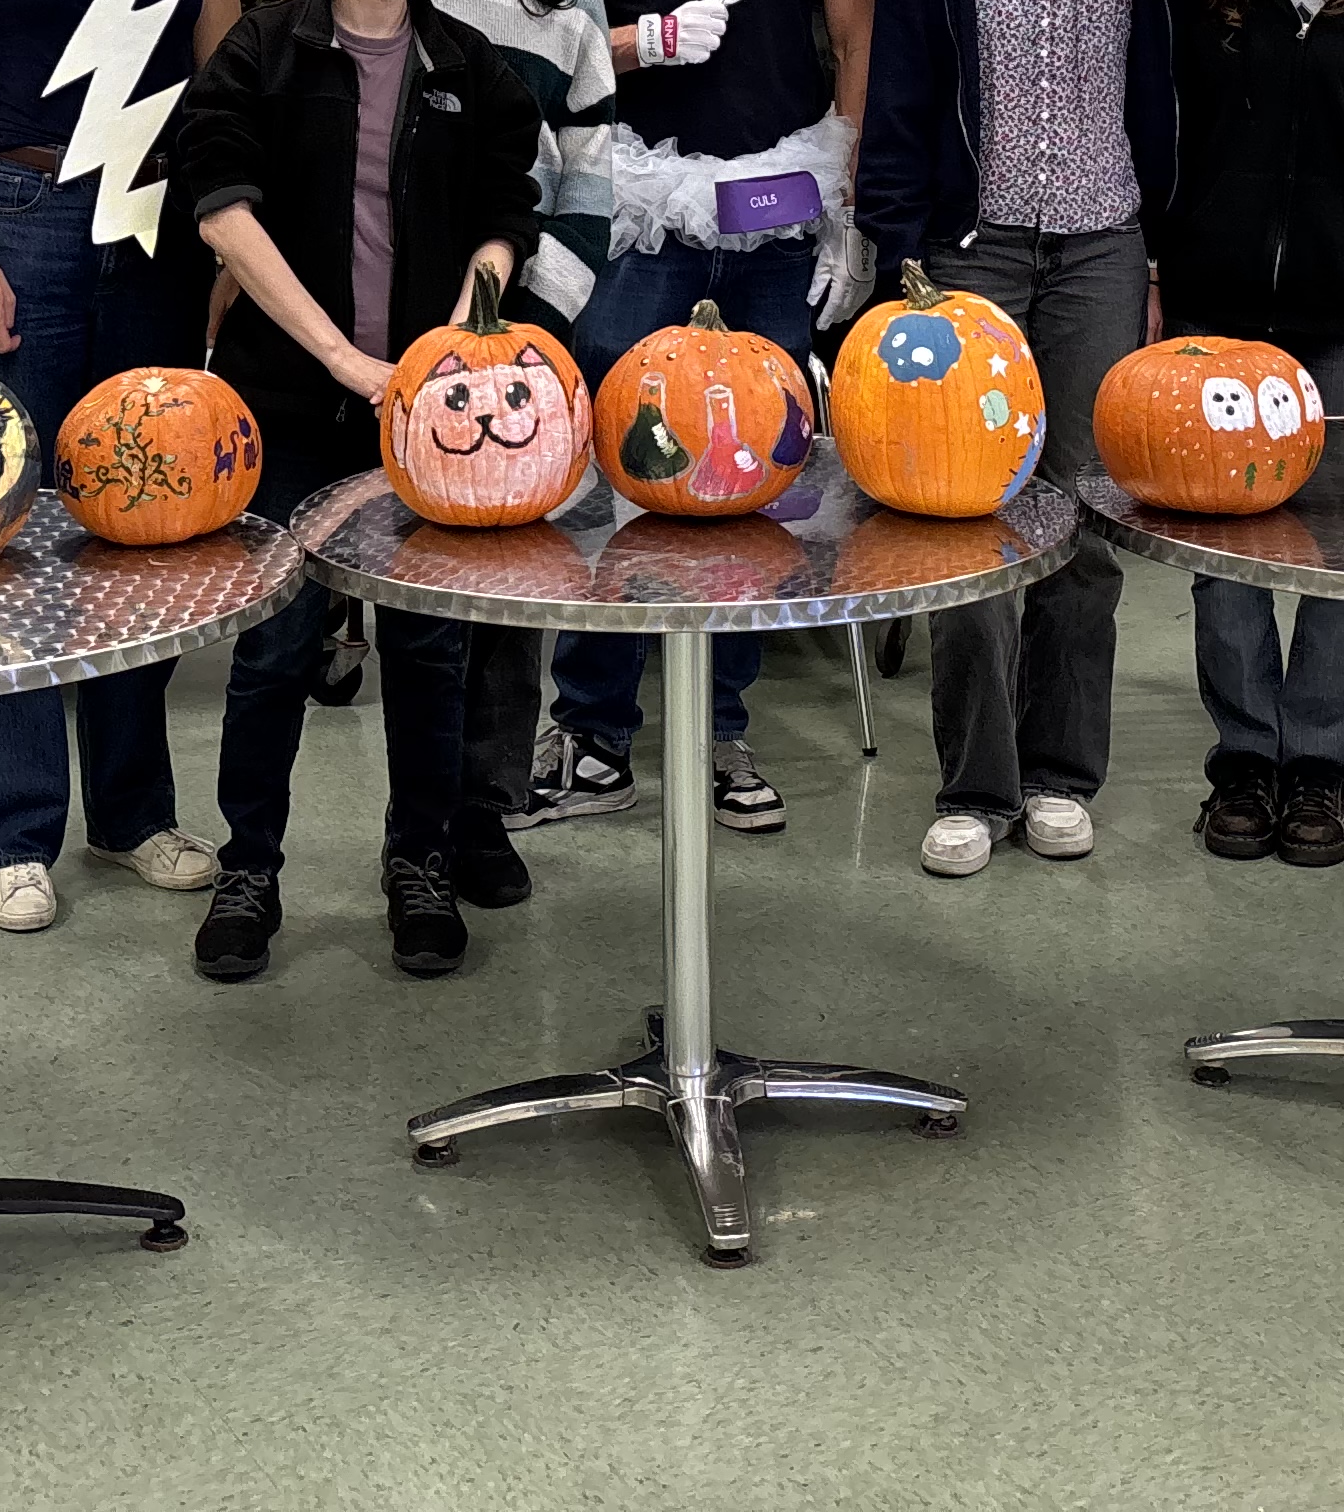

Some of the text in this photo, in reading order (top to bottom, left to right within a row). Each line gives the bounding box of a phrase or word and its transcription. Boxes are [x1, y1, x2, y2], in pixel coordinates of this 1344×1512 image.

[646, 19, 658, 58] ARIH2
[664, 19, 675, 53] RNF7
[749, 193, 778, 209] CUL5
